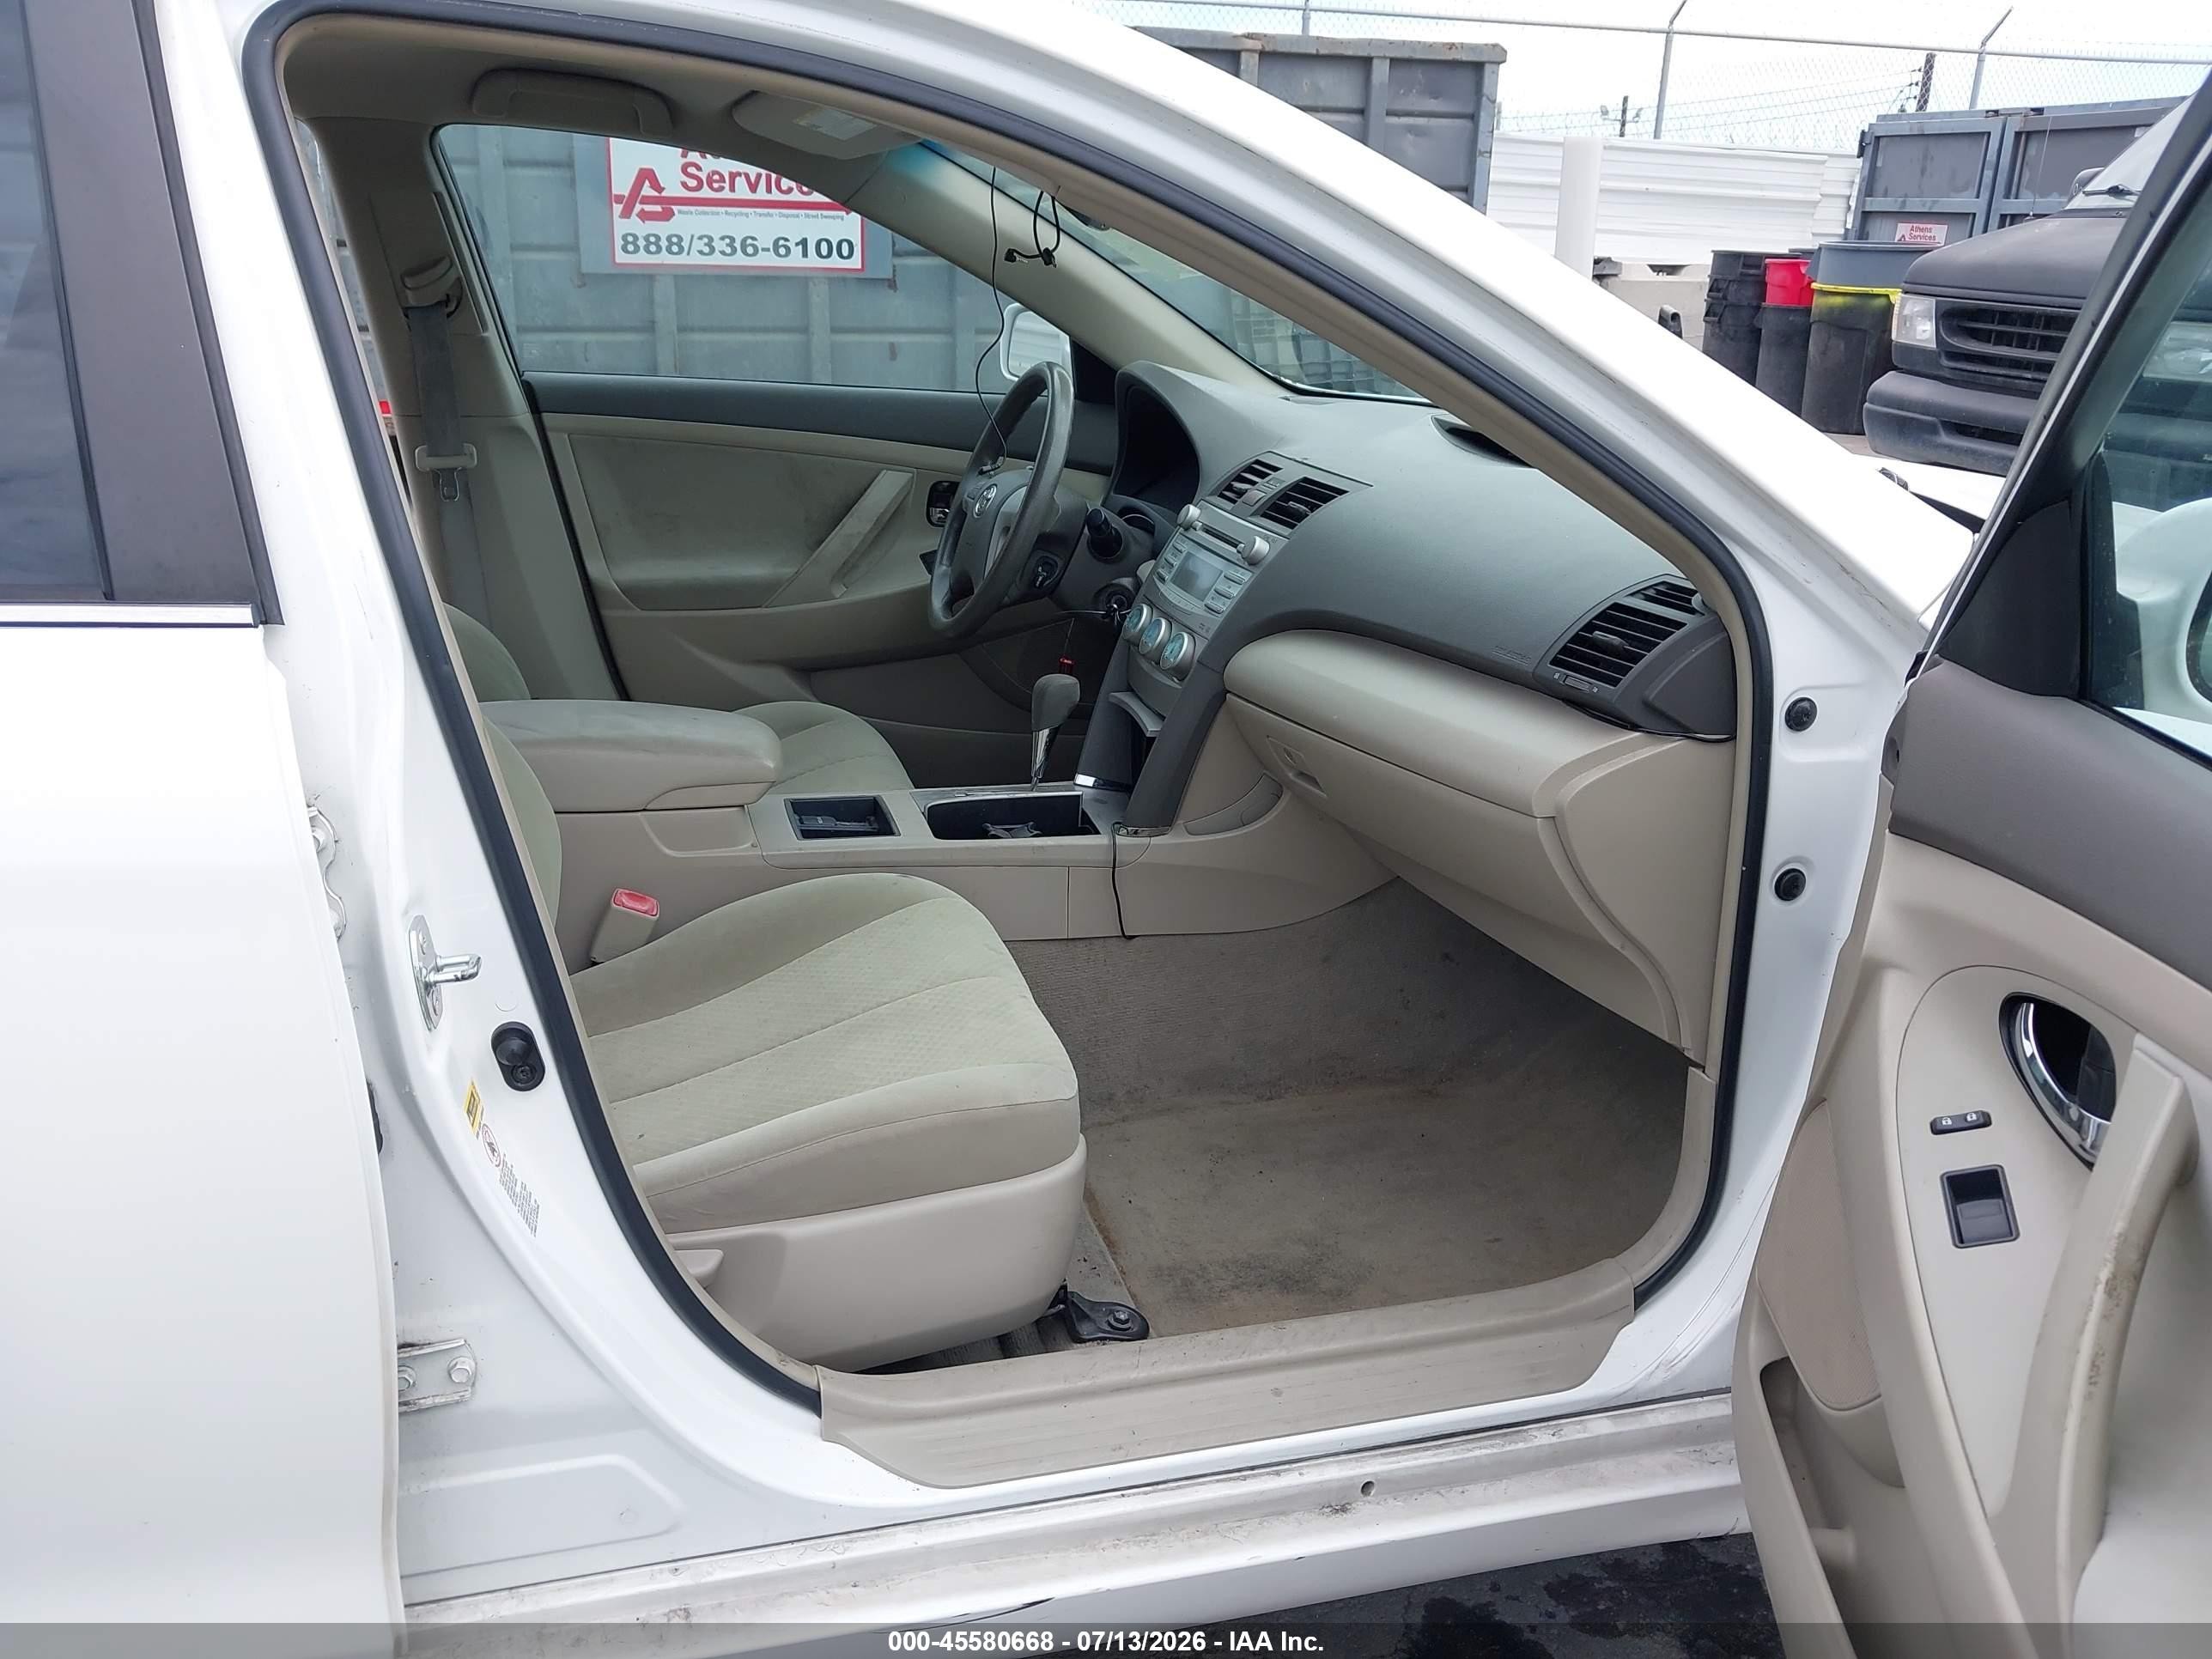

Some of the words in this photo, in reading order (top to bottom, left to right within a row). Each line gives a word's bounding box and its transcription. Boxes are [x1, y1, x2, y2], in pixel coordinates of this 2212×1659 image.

[725, 210, 750, 218] Recycling
[1909, 225, 1933, 234] Athens
[1908, 233, 1936, 241] Services
[620, 232, 855, 260] 888/336-6100
